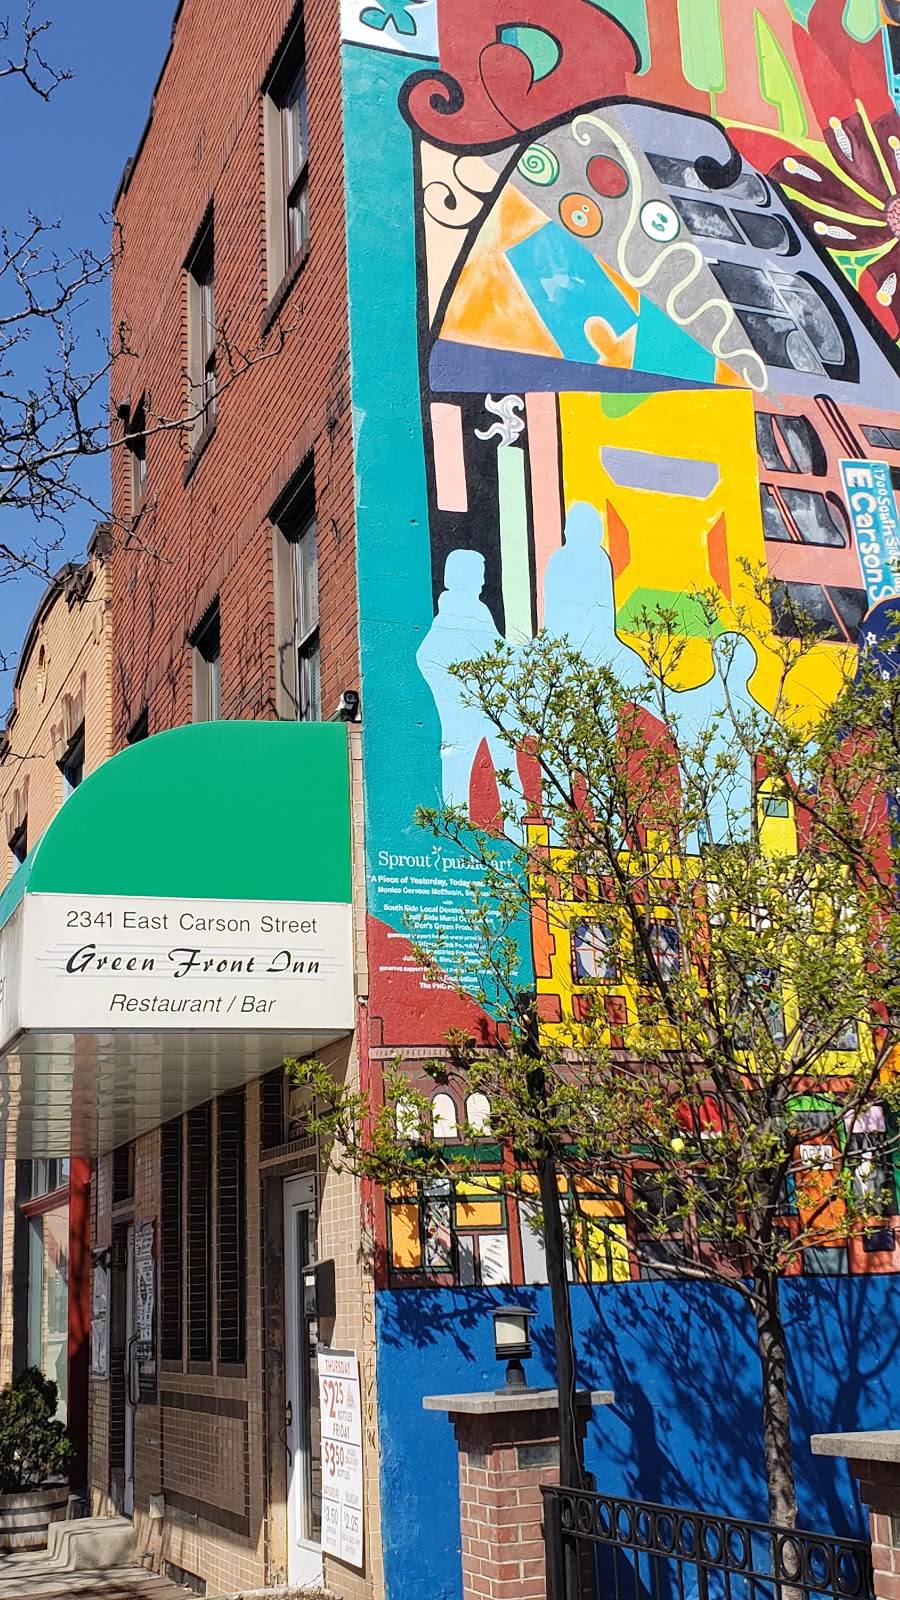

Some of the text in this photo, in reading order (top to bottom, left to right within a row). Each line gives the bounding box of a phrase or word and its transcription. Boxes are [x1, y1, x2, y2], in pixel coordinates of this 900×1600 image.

[844, 467, 874, 489] E
[850, 491, 884, 584] Carson
[378, 850, 432, 870] Sprout
[490, 858, 514, 872] art
[377, 875, 399, 884] Piece
[400, 876, 409, 884] of
[410, 877, 448, 888] Yesterday,
[377, 886, 402, 894] Monica
[420, 905, 439, 913] Local
[66, 910, 318, 934] 2341 East Carson Street
[66, 943, 320, 978] Green Front Inn
[109, 993, 223, 1013] Restaurant
[240, 995, 277, 1013] Bar
[325, 1359, 351, 1375] THURSDAY
[333, 1422, 350, 1439] FRIDAY
